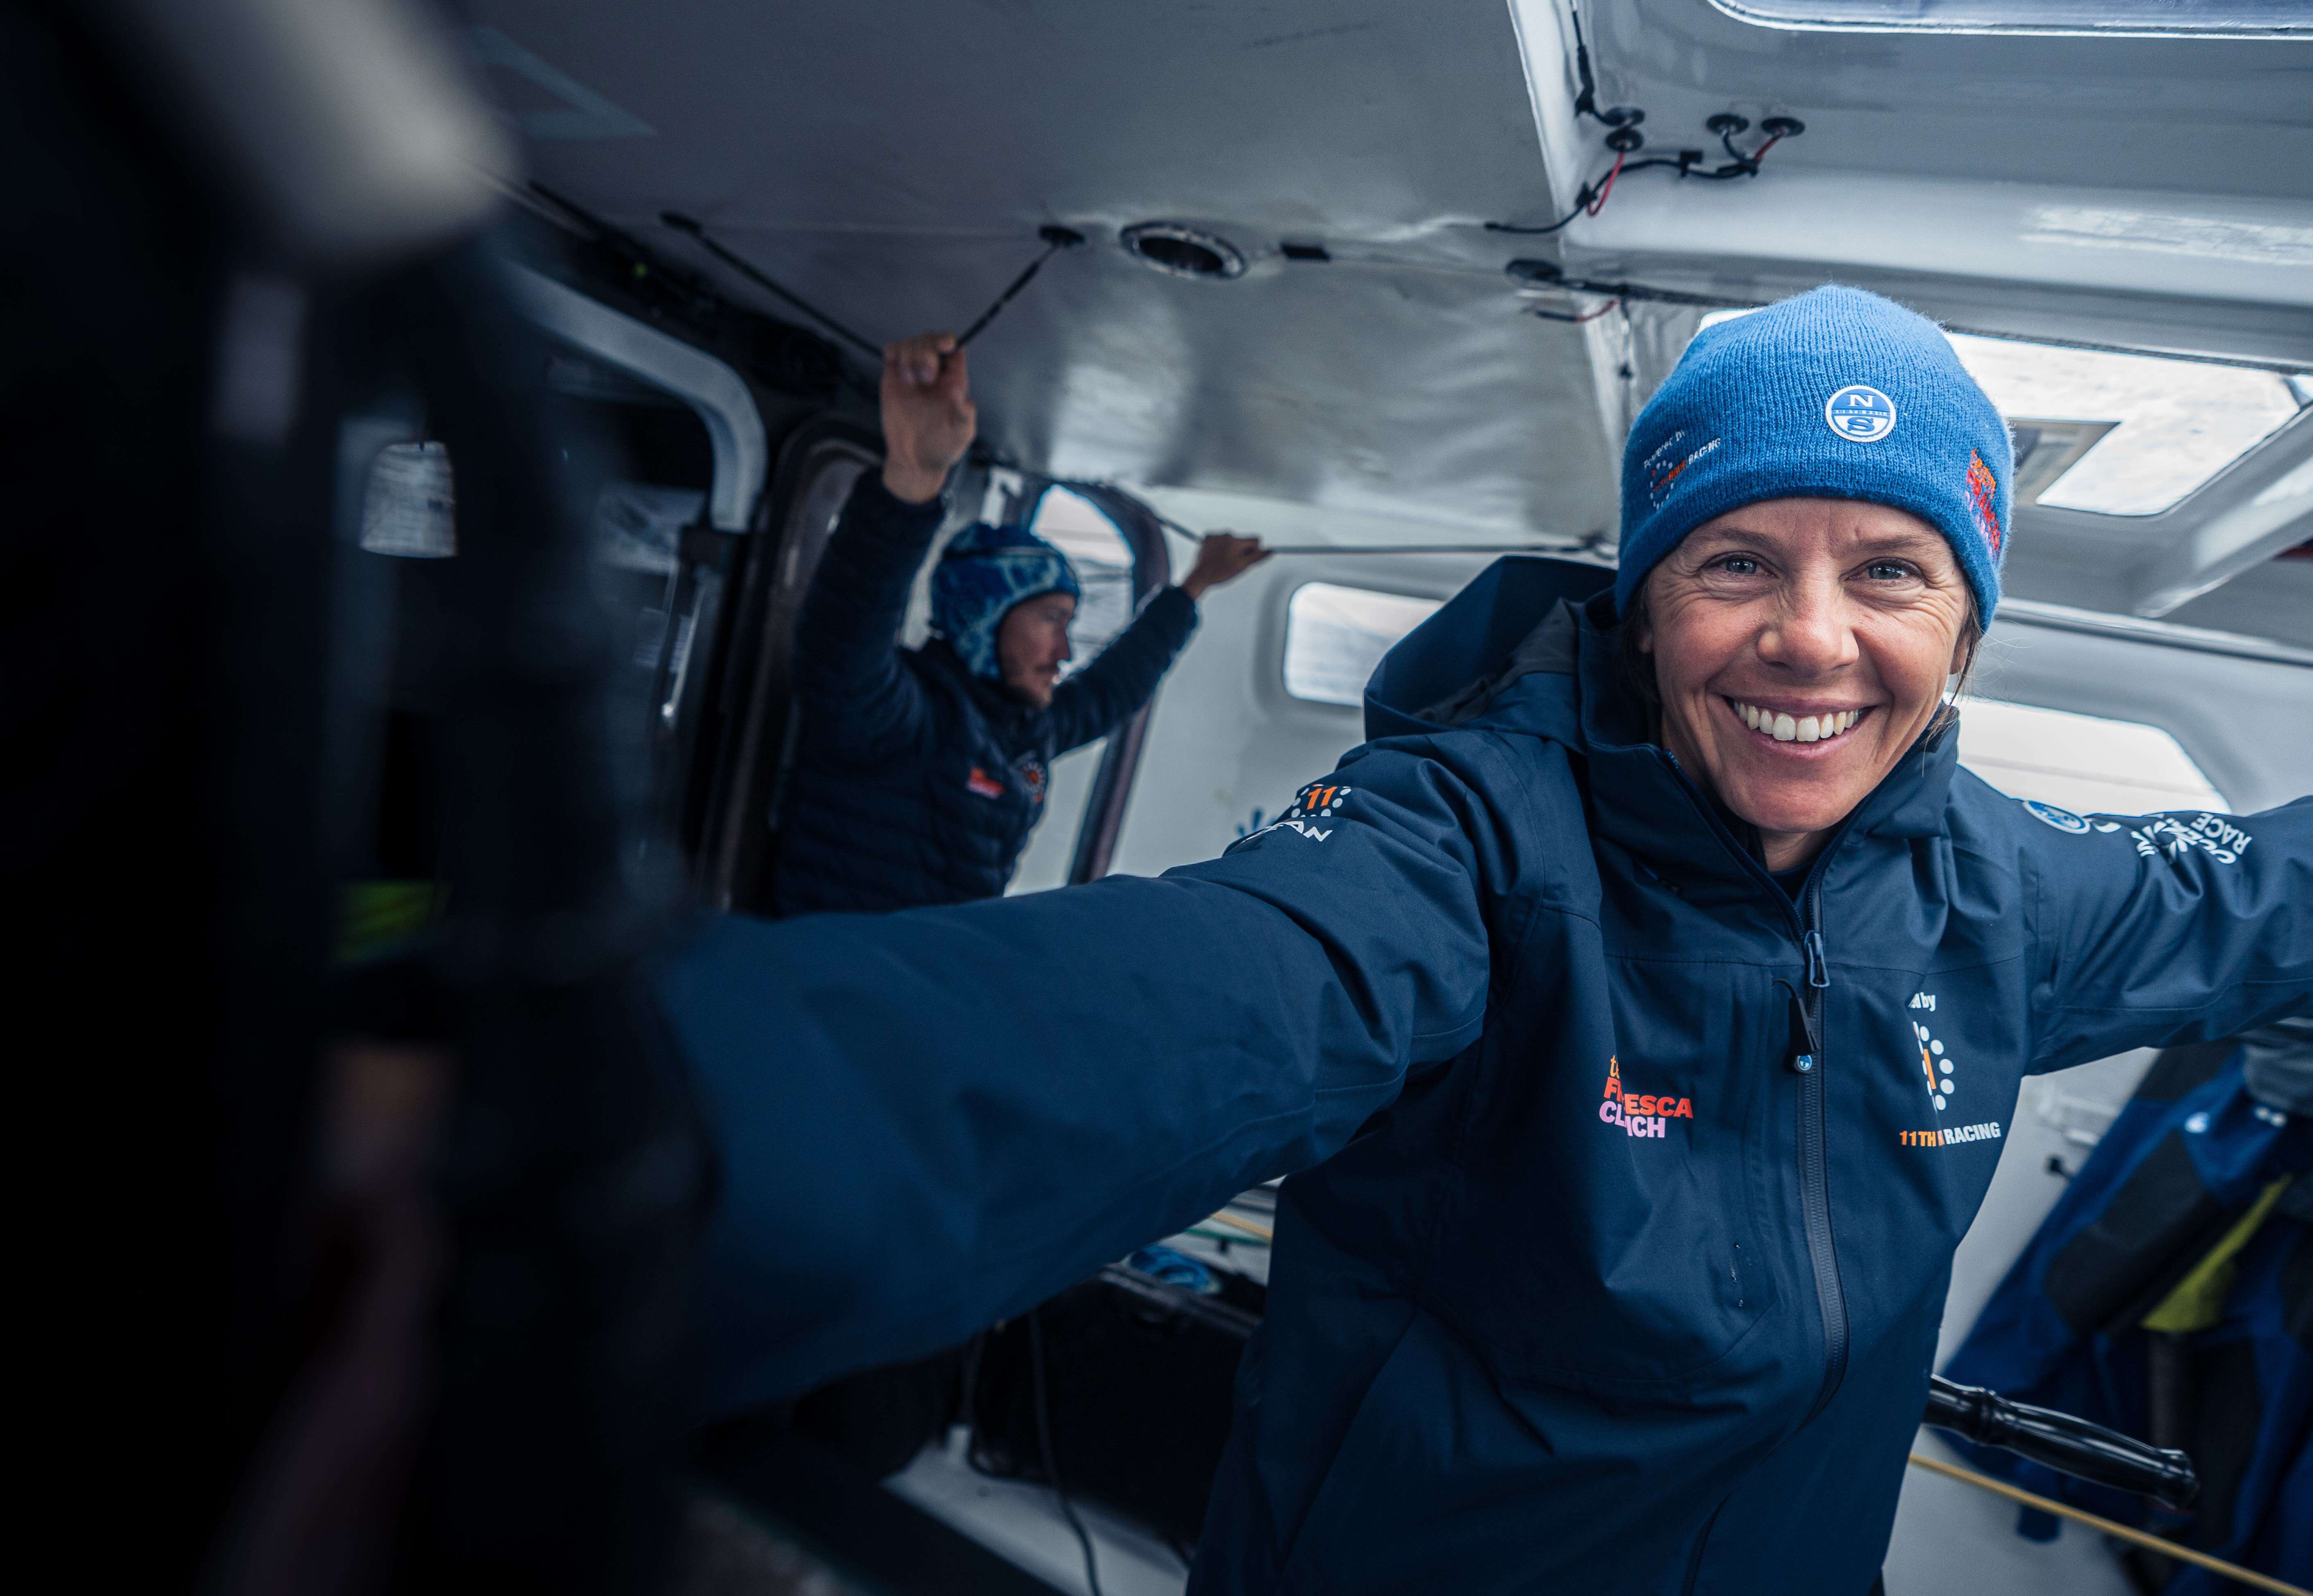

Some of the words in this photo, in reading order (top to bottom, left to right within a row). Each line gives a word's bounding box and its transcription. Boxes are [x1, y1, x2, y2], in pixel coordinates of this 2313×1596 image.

[1847, 393, 1876, 407] N
[1847, 417, 1875, 431] S
[1307, 786, 1337, 810] 11
[2190, 812, 2252, 855] RACE
[1900, 1131, 1936, 1147] 11TH
[1943, 1122, 2001, 1145] RACING
